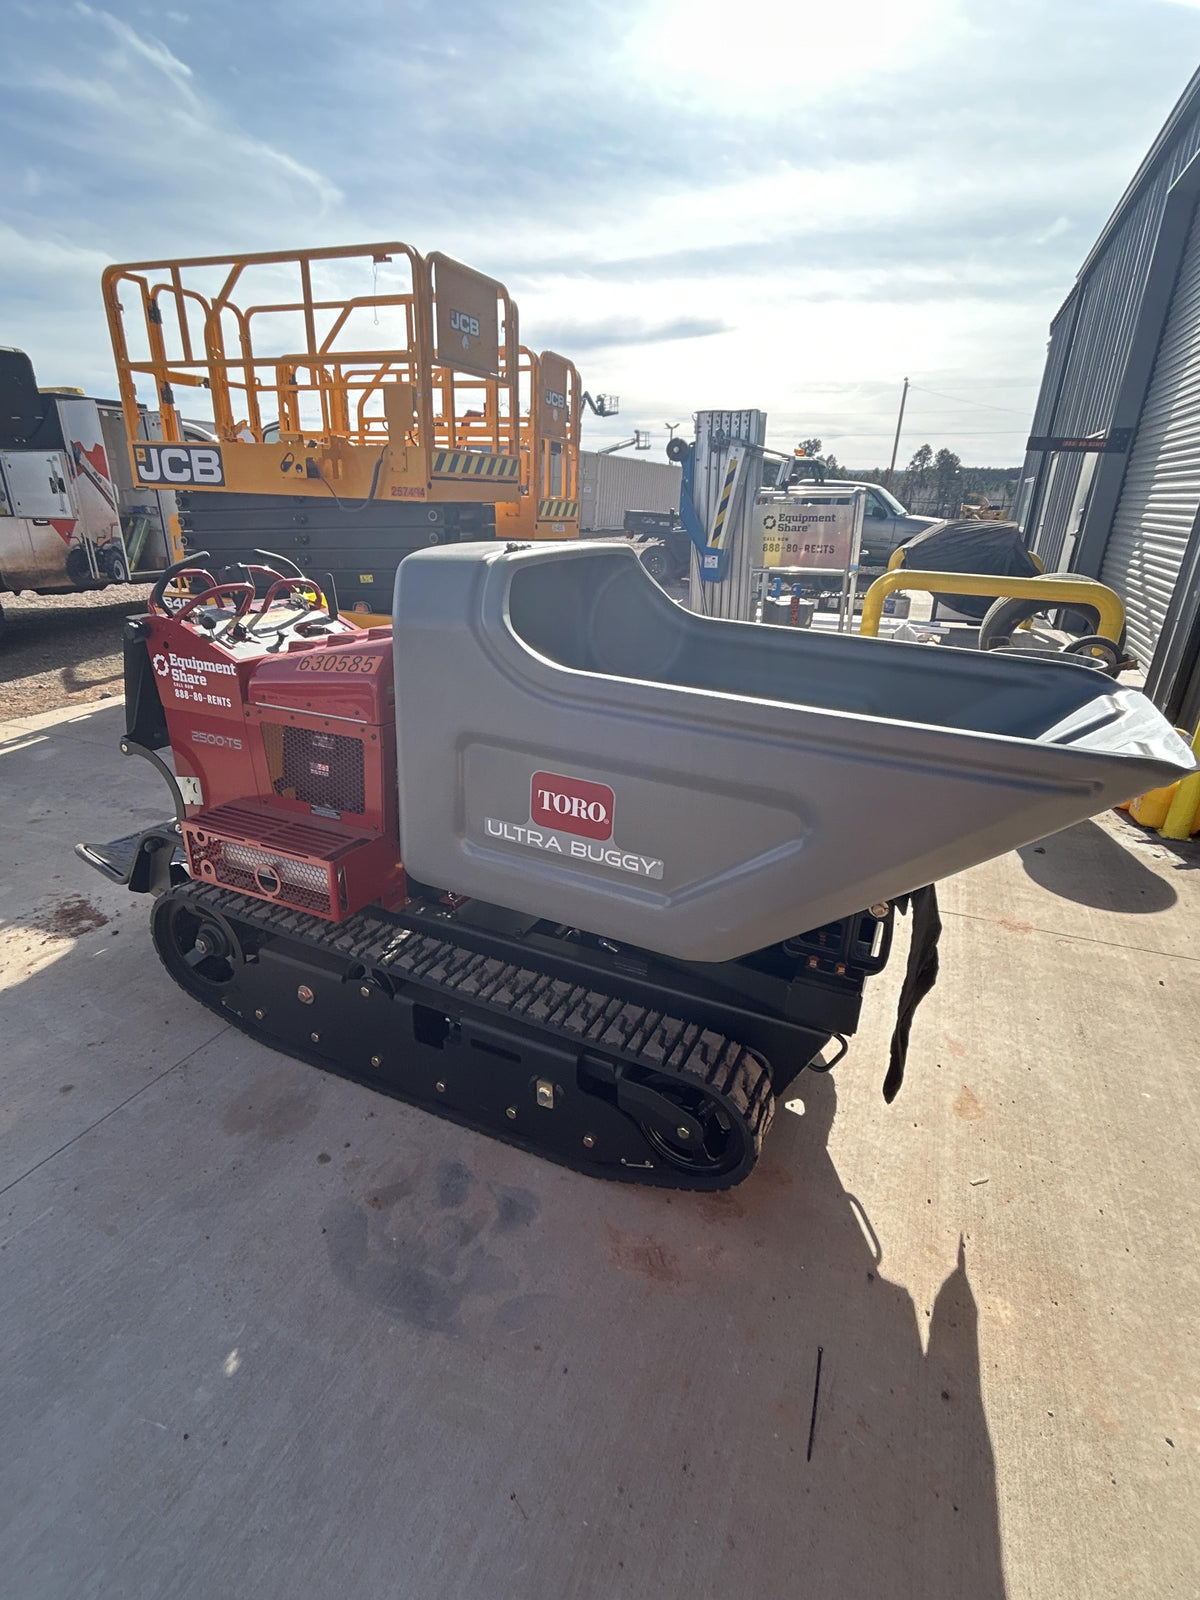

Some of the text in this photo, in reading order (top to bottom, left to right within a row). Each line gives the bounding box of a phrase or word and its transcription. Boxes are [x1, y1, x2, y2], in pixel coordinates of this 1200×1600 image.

[450, 311, 480, 337] JCB
[545, 391, 565, 409] JCB
[138, 448, 222, 483] JCB
[777, 523, 809, 532] Share
[778, 513, 837, 524] Equipment
[762, 543, 835, 554] 888-80-RENTS
[168, 653, 237, 676] Equipment
[299, 655, 377, 673] 630585
[171, 668, 207, 686] Share
[174, 688, 232, 708] 888-80-RENTS
[537, 789, 607, 823] TORO
[487, 819, 657, 875] ULTRA BUGGY
